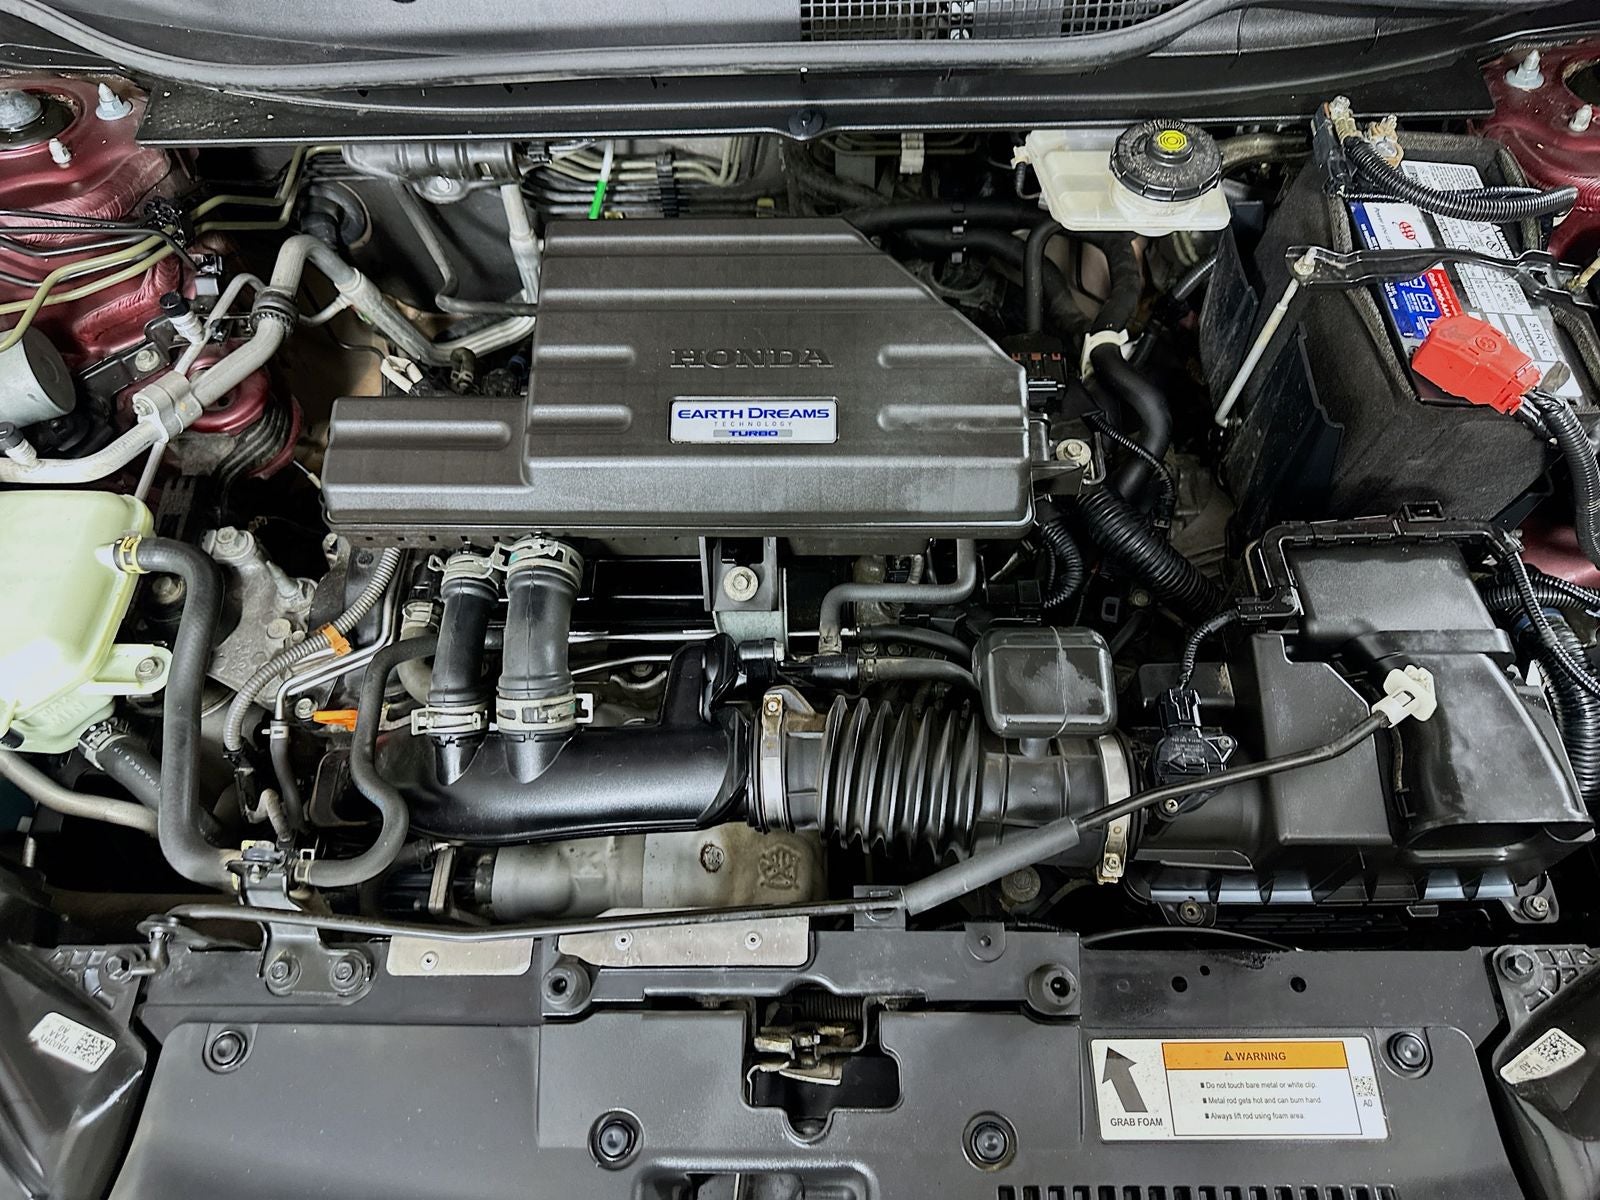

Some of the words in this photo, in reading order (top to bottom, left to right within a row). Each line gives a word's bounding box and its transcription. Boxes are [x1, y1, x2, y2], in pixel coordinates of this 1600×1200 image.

[670, 349, 835, 369] HONDA
[677, 409, 743, 419] EARTH
[748, 407, 830, 419] DREAMS
[1235, 1051, 1287, 1061] WARNING
[1206, 1081, 1216, 1089] Do
[1216, 1081, 1227, 1089] not
[1227, 1081, 1245, 1089] touch
[1245, 1081, 1260, 1089] bare
[1261, 1081, 1279, 1089] metal
[1279, 1081, 1286, 1089] or
[1287, 1081, 1304, 1089] white
[1238, 1097, 1252, 1106] gets
[1210, 1112, 1233, 1121] Always
[1254, 1112, 1271, 1121] using
[1110, 1117, 1136, 1127] GRAB
[1138, 1117, 1164, 1127] FOAM
